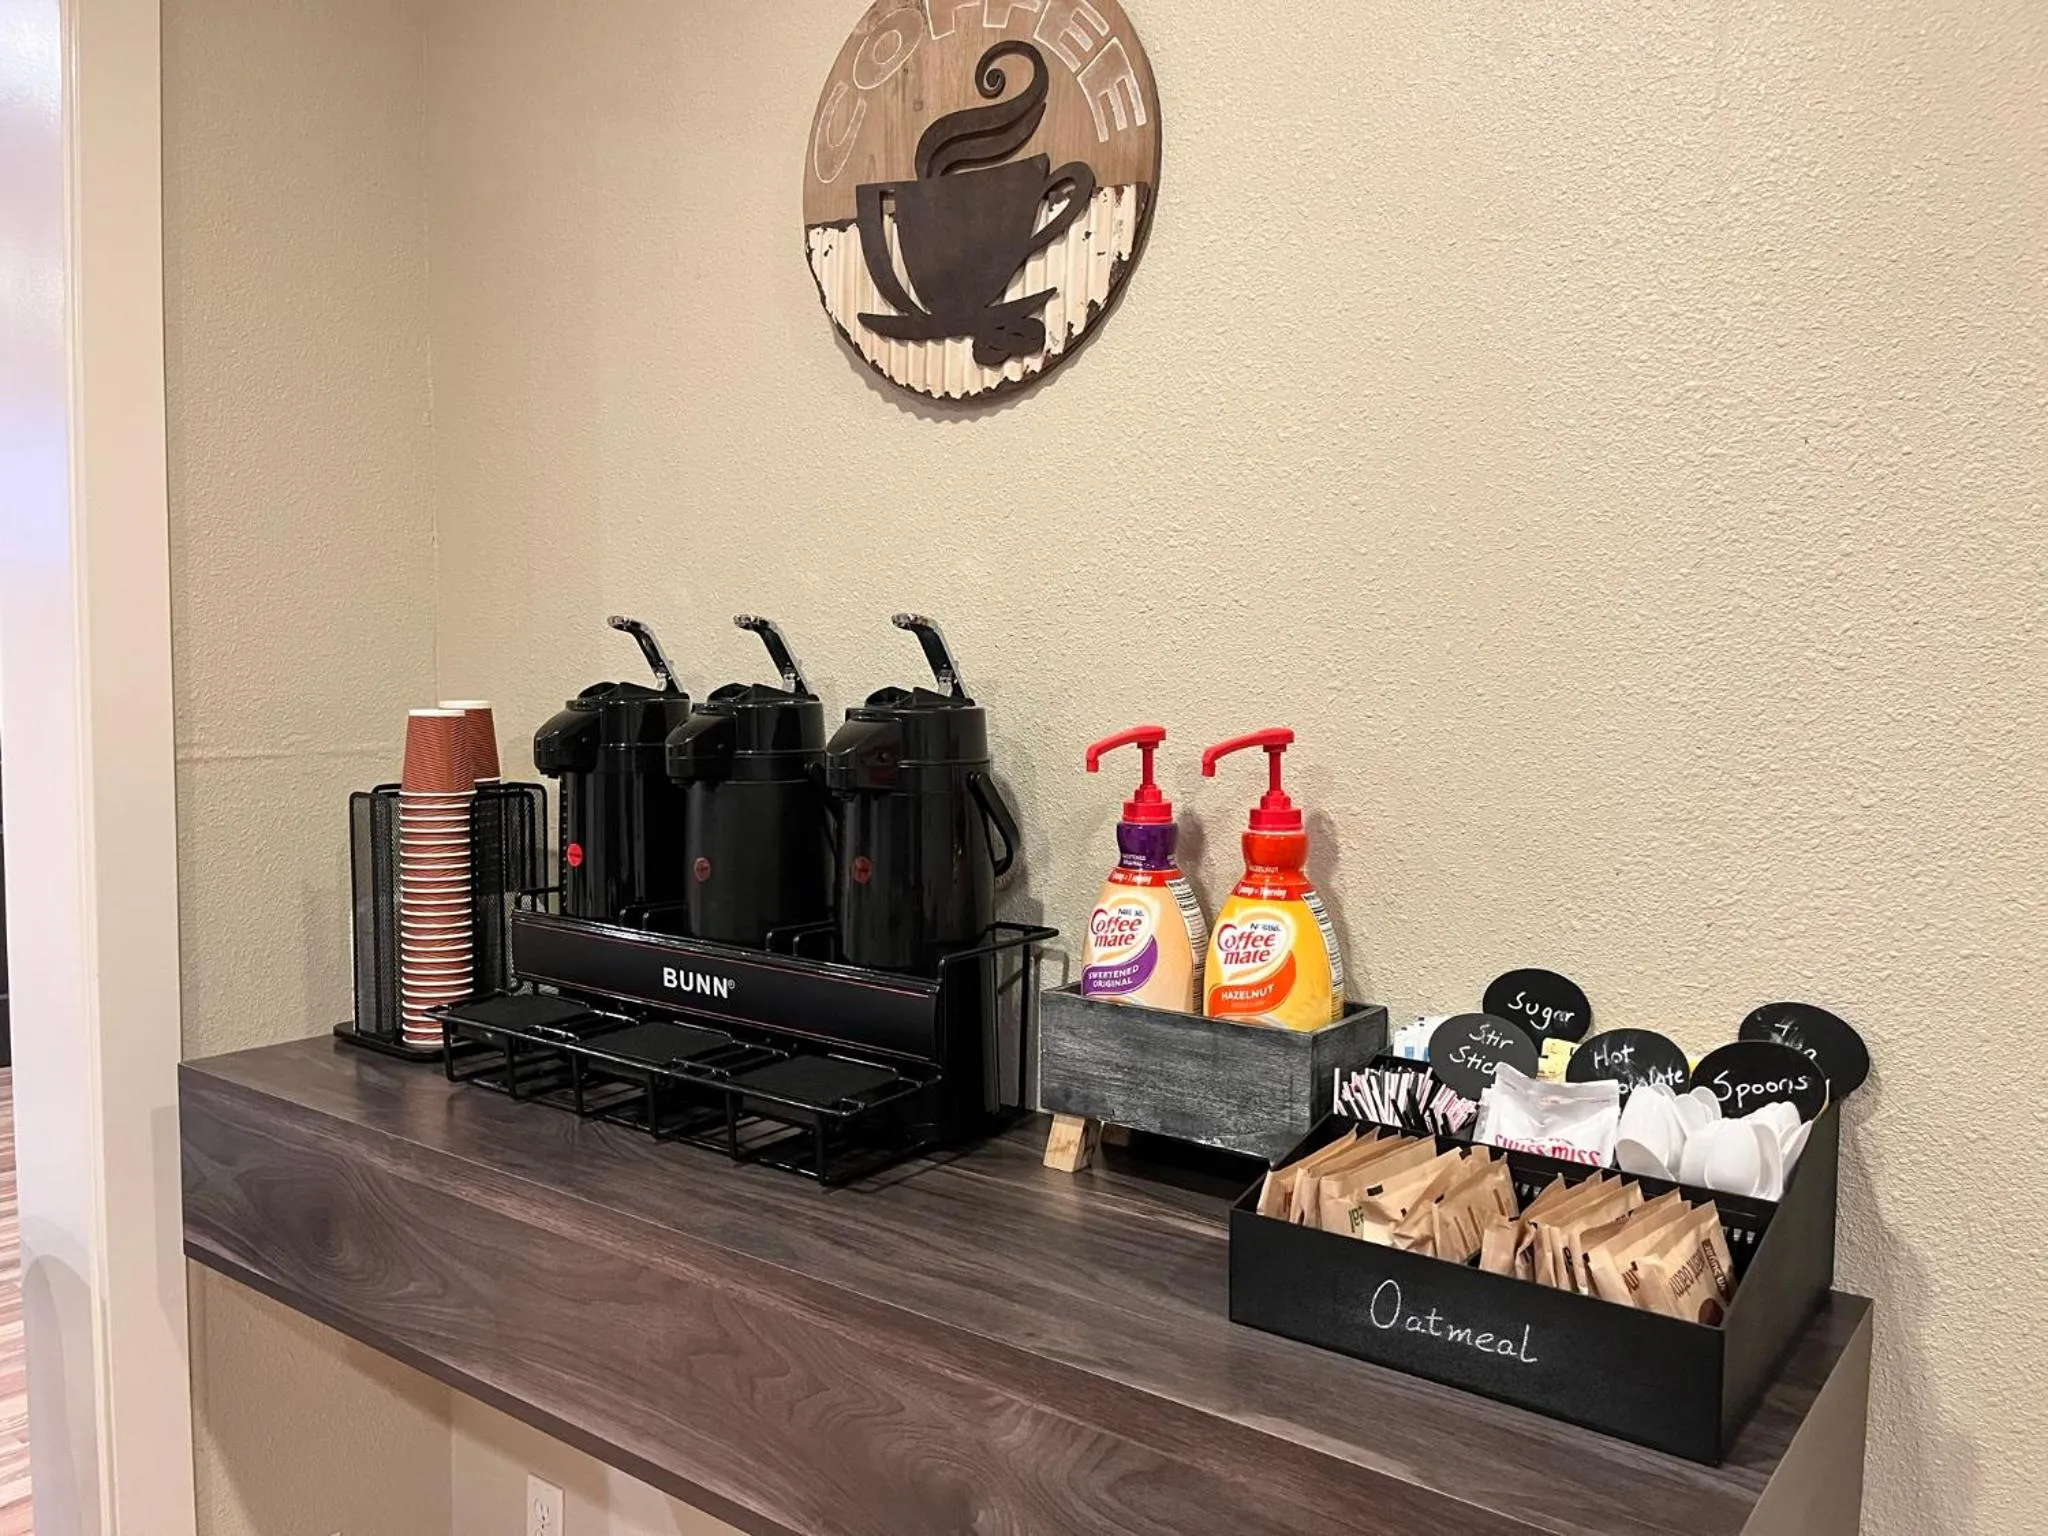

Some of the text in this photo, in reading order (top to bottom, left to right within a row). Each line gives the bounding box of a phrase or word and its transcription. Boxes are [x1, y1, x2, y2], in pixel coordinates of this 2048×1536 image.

[1090, 908, 1142, 935] Coffee
[1094, 932, 1136, 948] mate
[1217, 922, 1276, 952] Coffee
[1223, 949, 1272, 965] mate
[1092, 977, 1133, 989] ORIGINAL
[1221, 984, 1275, 1000] HAZELNUT
[1507, 990, 1576, 1031] Sugar
[1468, 1023, 1514, 1050] Stir
[1593, 1043, 1636, 1070] Hot
[1711, 1069, 1810, 1109] Spoons
[1369, 1278, 1540, 1364] Oatmeal
